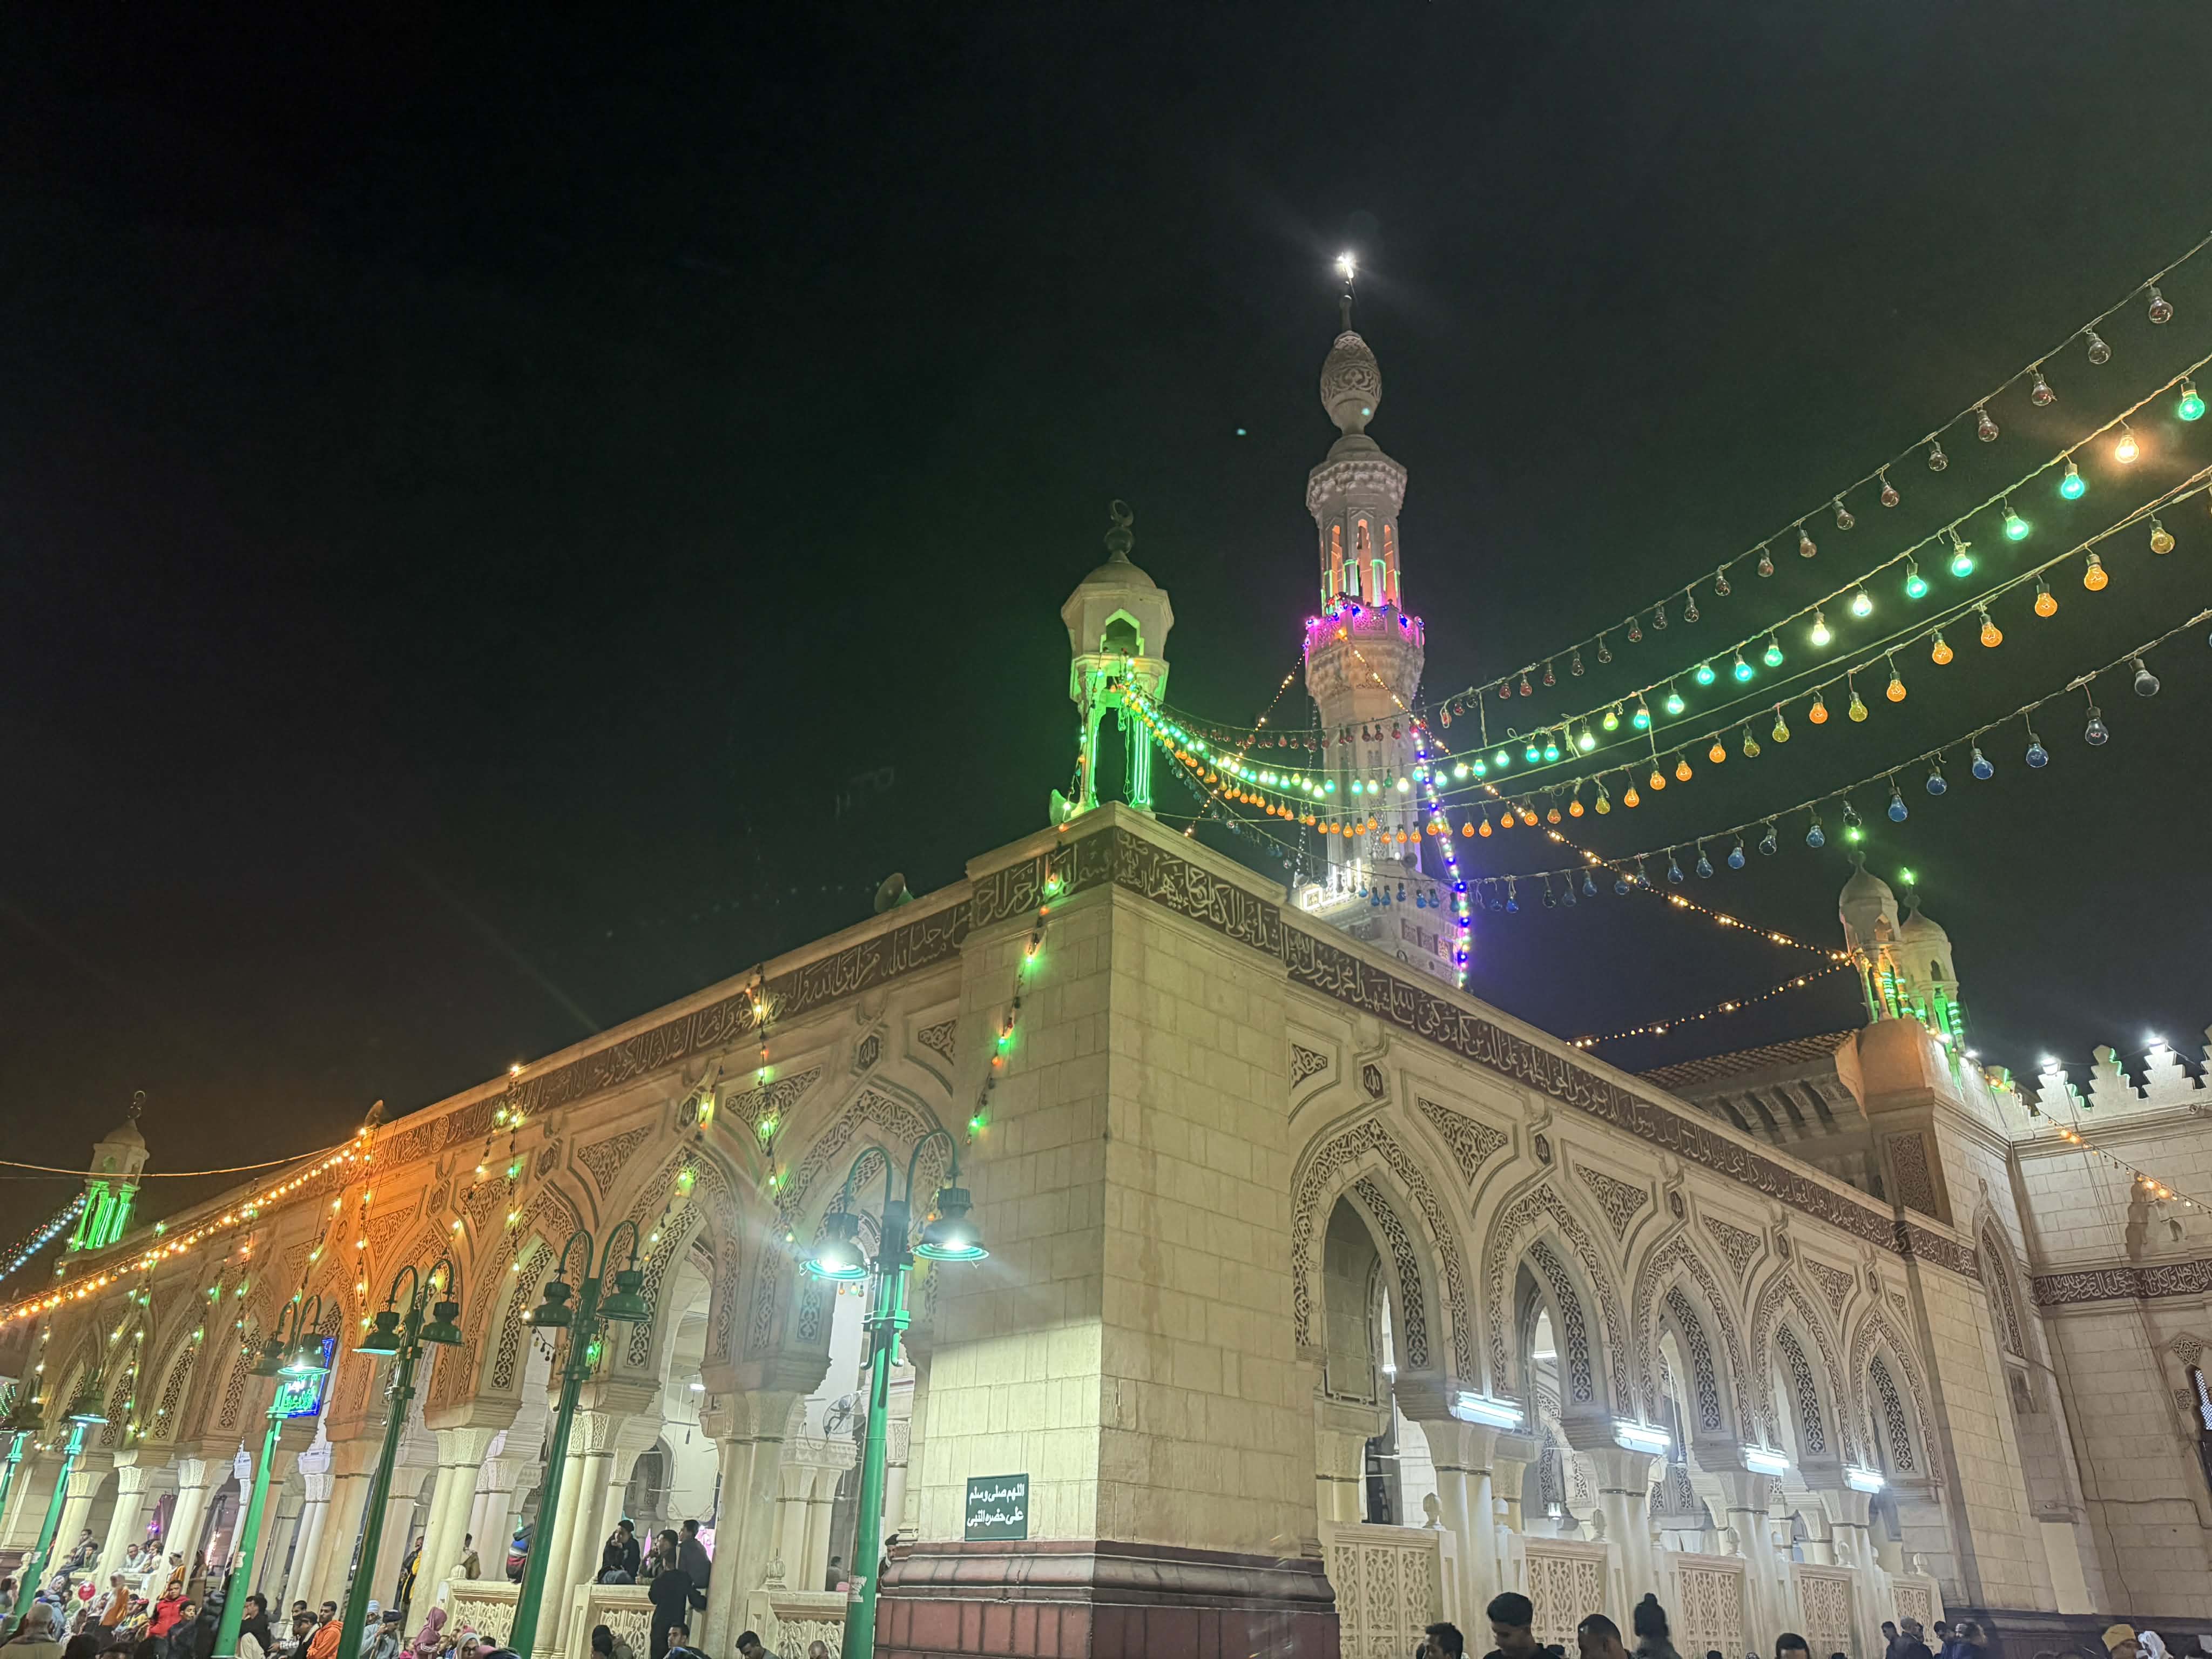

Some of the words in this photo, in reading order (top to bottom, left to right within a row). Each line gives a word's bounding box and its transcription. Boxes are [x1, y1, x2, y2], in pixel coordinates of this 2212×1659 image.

[969, 1486, 988, 1505] وسلم
[988, 1484, 1007, 1502] صلى
[1007, 1483, 1024, 1503] اللهم
[1005, 1506, 1024, 1525] على
